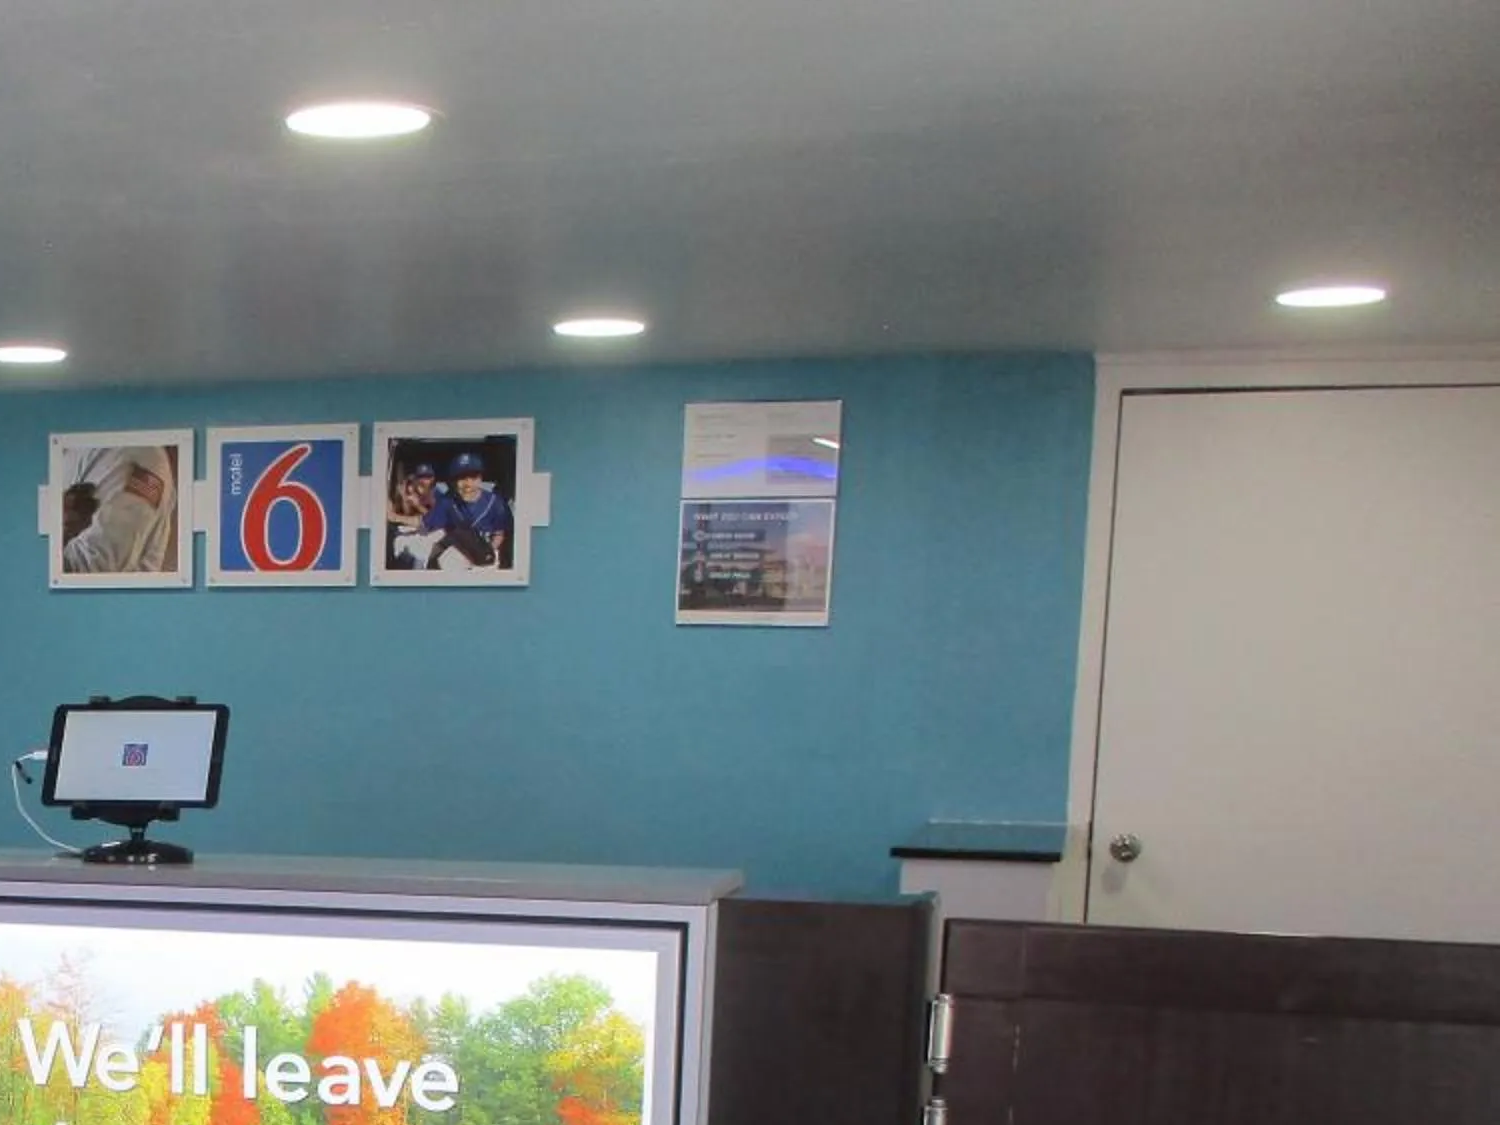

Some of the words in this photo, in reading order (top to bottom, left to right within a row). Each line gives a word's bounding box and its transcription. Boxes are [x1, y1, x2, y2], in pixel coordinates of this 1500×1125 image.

[229, 452, 243, 495] motel
[240, 443, 327, 573] 6
[18, 1017, 208, 1095] We'll
[243, 1025, 460, 1111] leave
